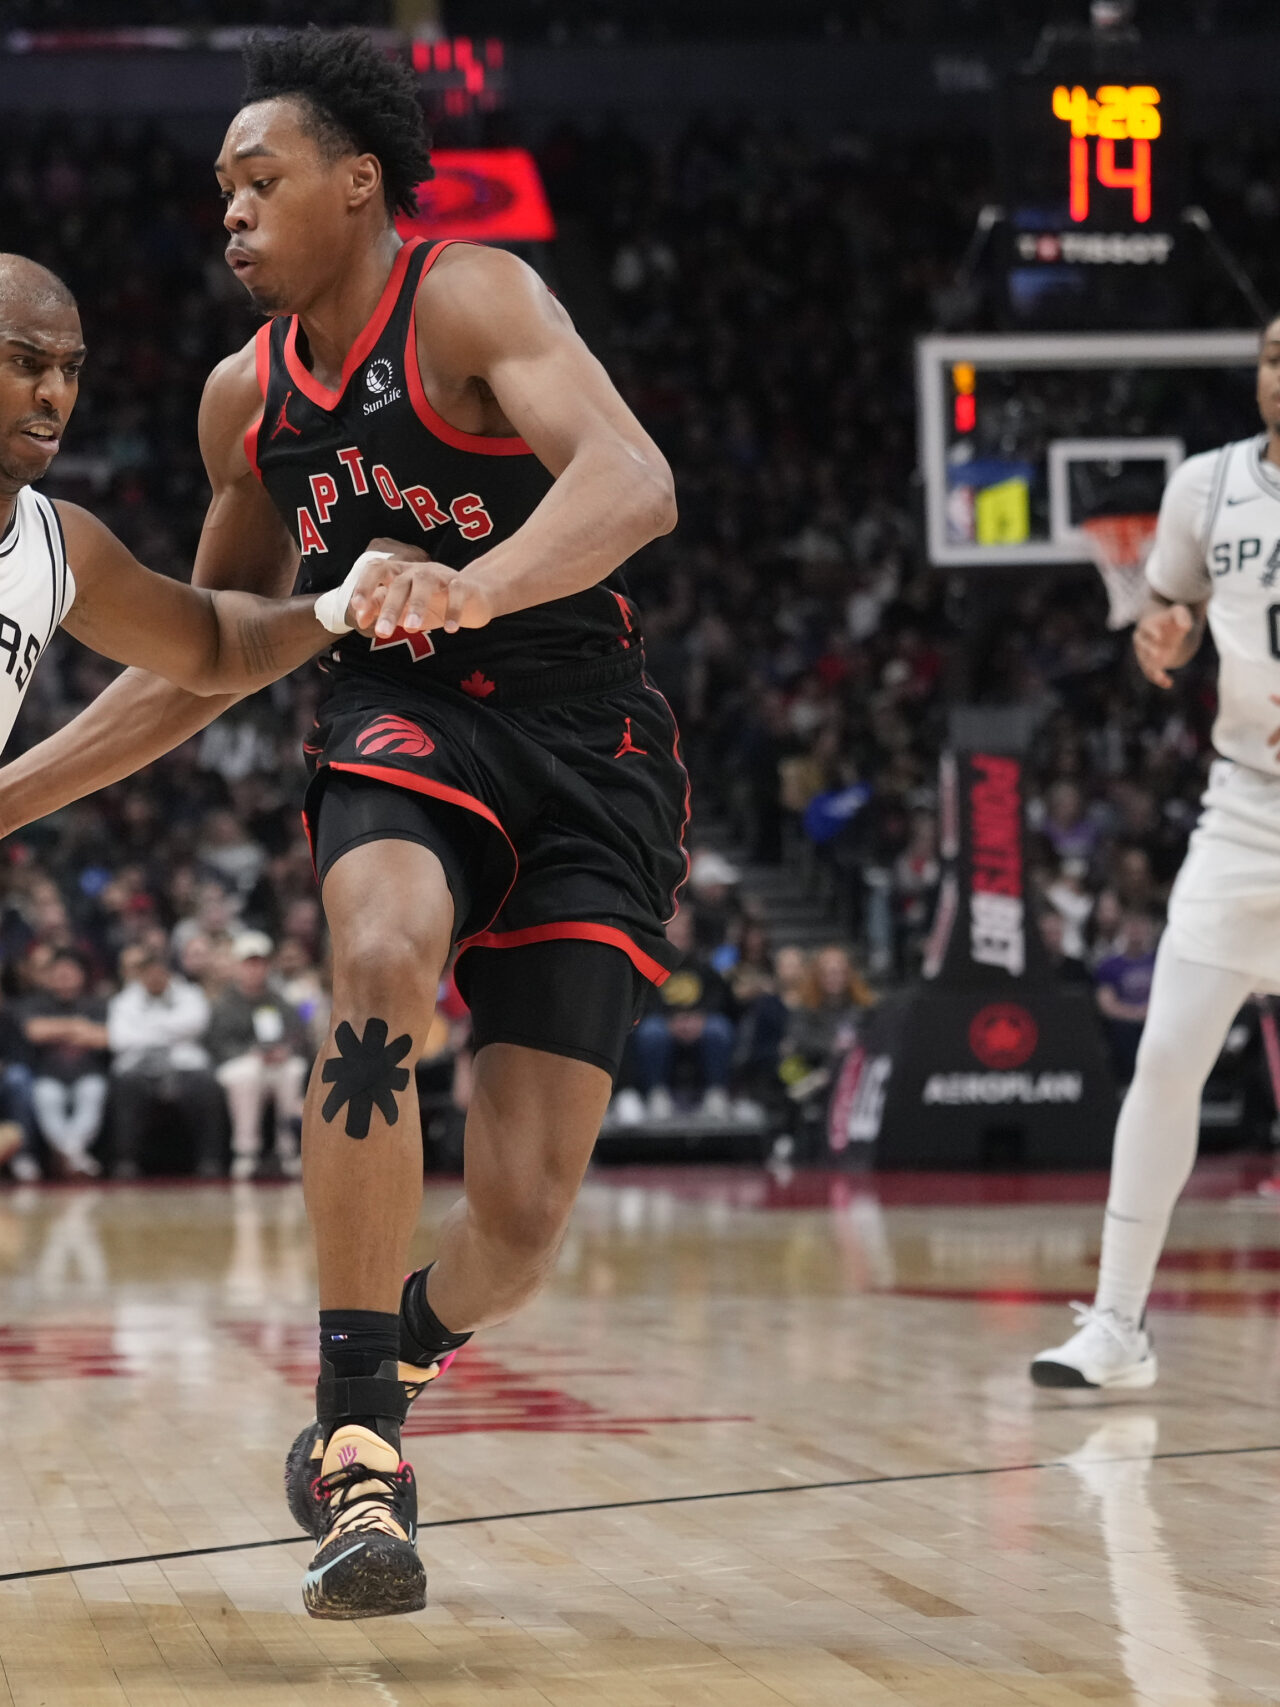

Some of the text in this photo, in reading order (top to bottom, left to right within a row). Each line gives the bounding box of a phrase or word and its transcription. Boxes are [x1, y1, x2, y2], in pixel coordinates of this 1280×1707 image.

[1052, 85, 1161, 139] 4:26
[1070, 137, 1152, 223] 14
[362, 387, 402, 416] Sun Life
[923, 1071, 1083, 1104] AEROPLAN
